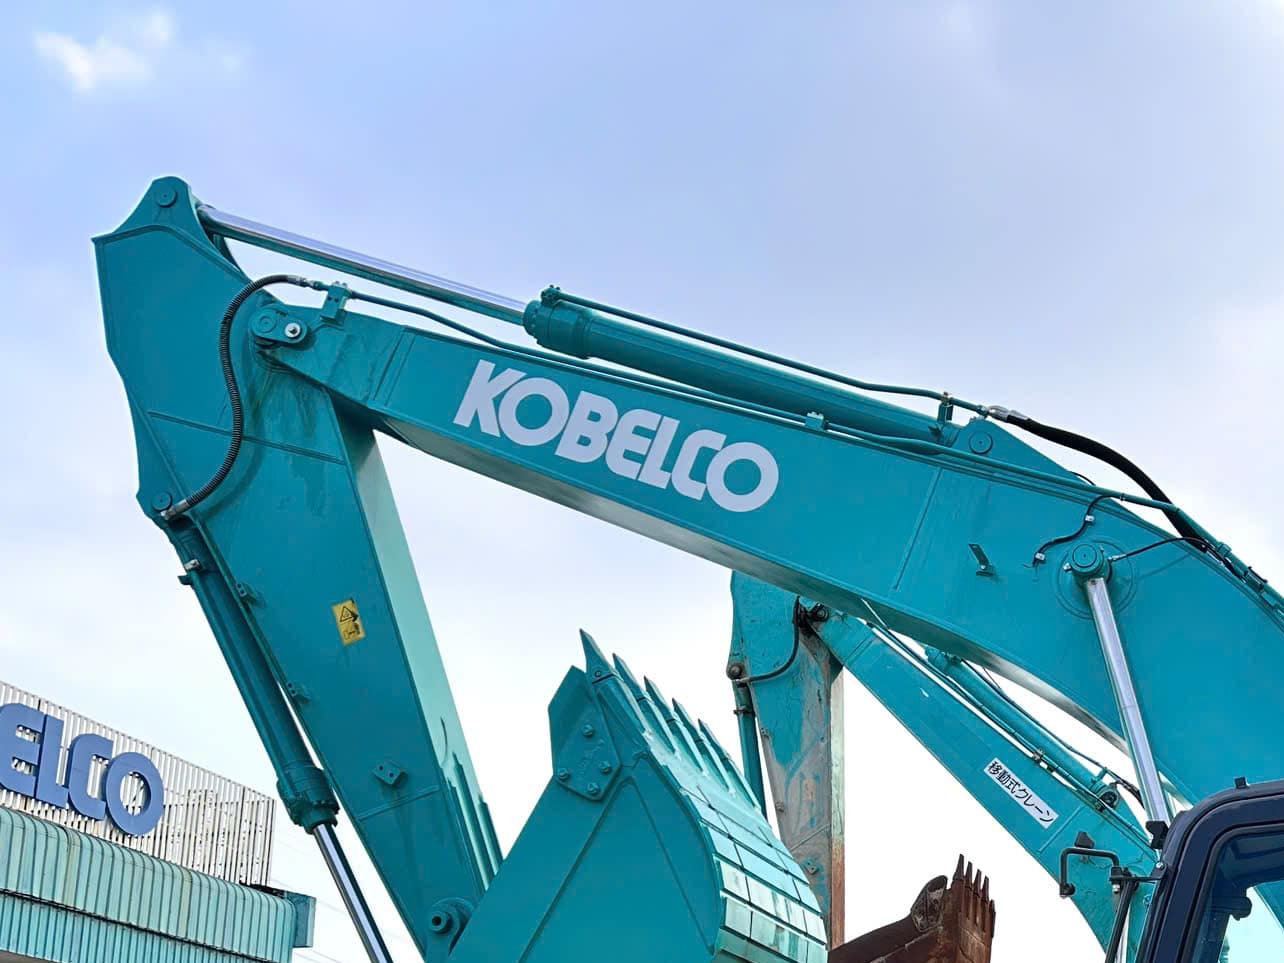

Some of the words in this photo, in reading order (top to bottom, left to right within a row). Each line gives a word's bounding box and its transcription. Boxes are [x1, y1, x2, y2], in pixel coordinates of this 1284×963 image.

[453, 359, 779, 513] KOBELCO
[987, 761, 1054, 823] 移動式クレーン
